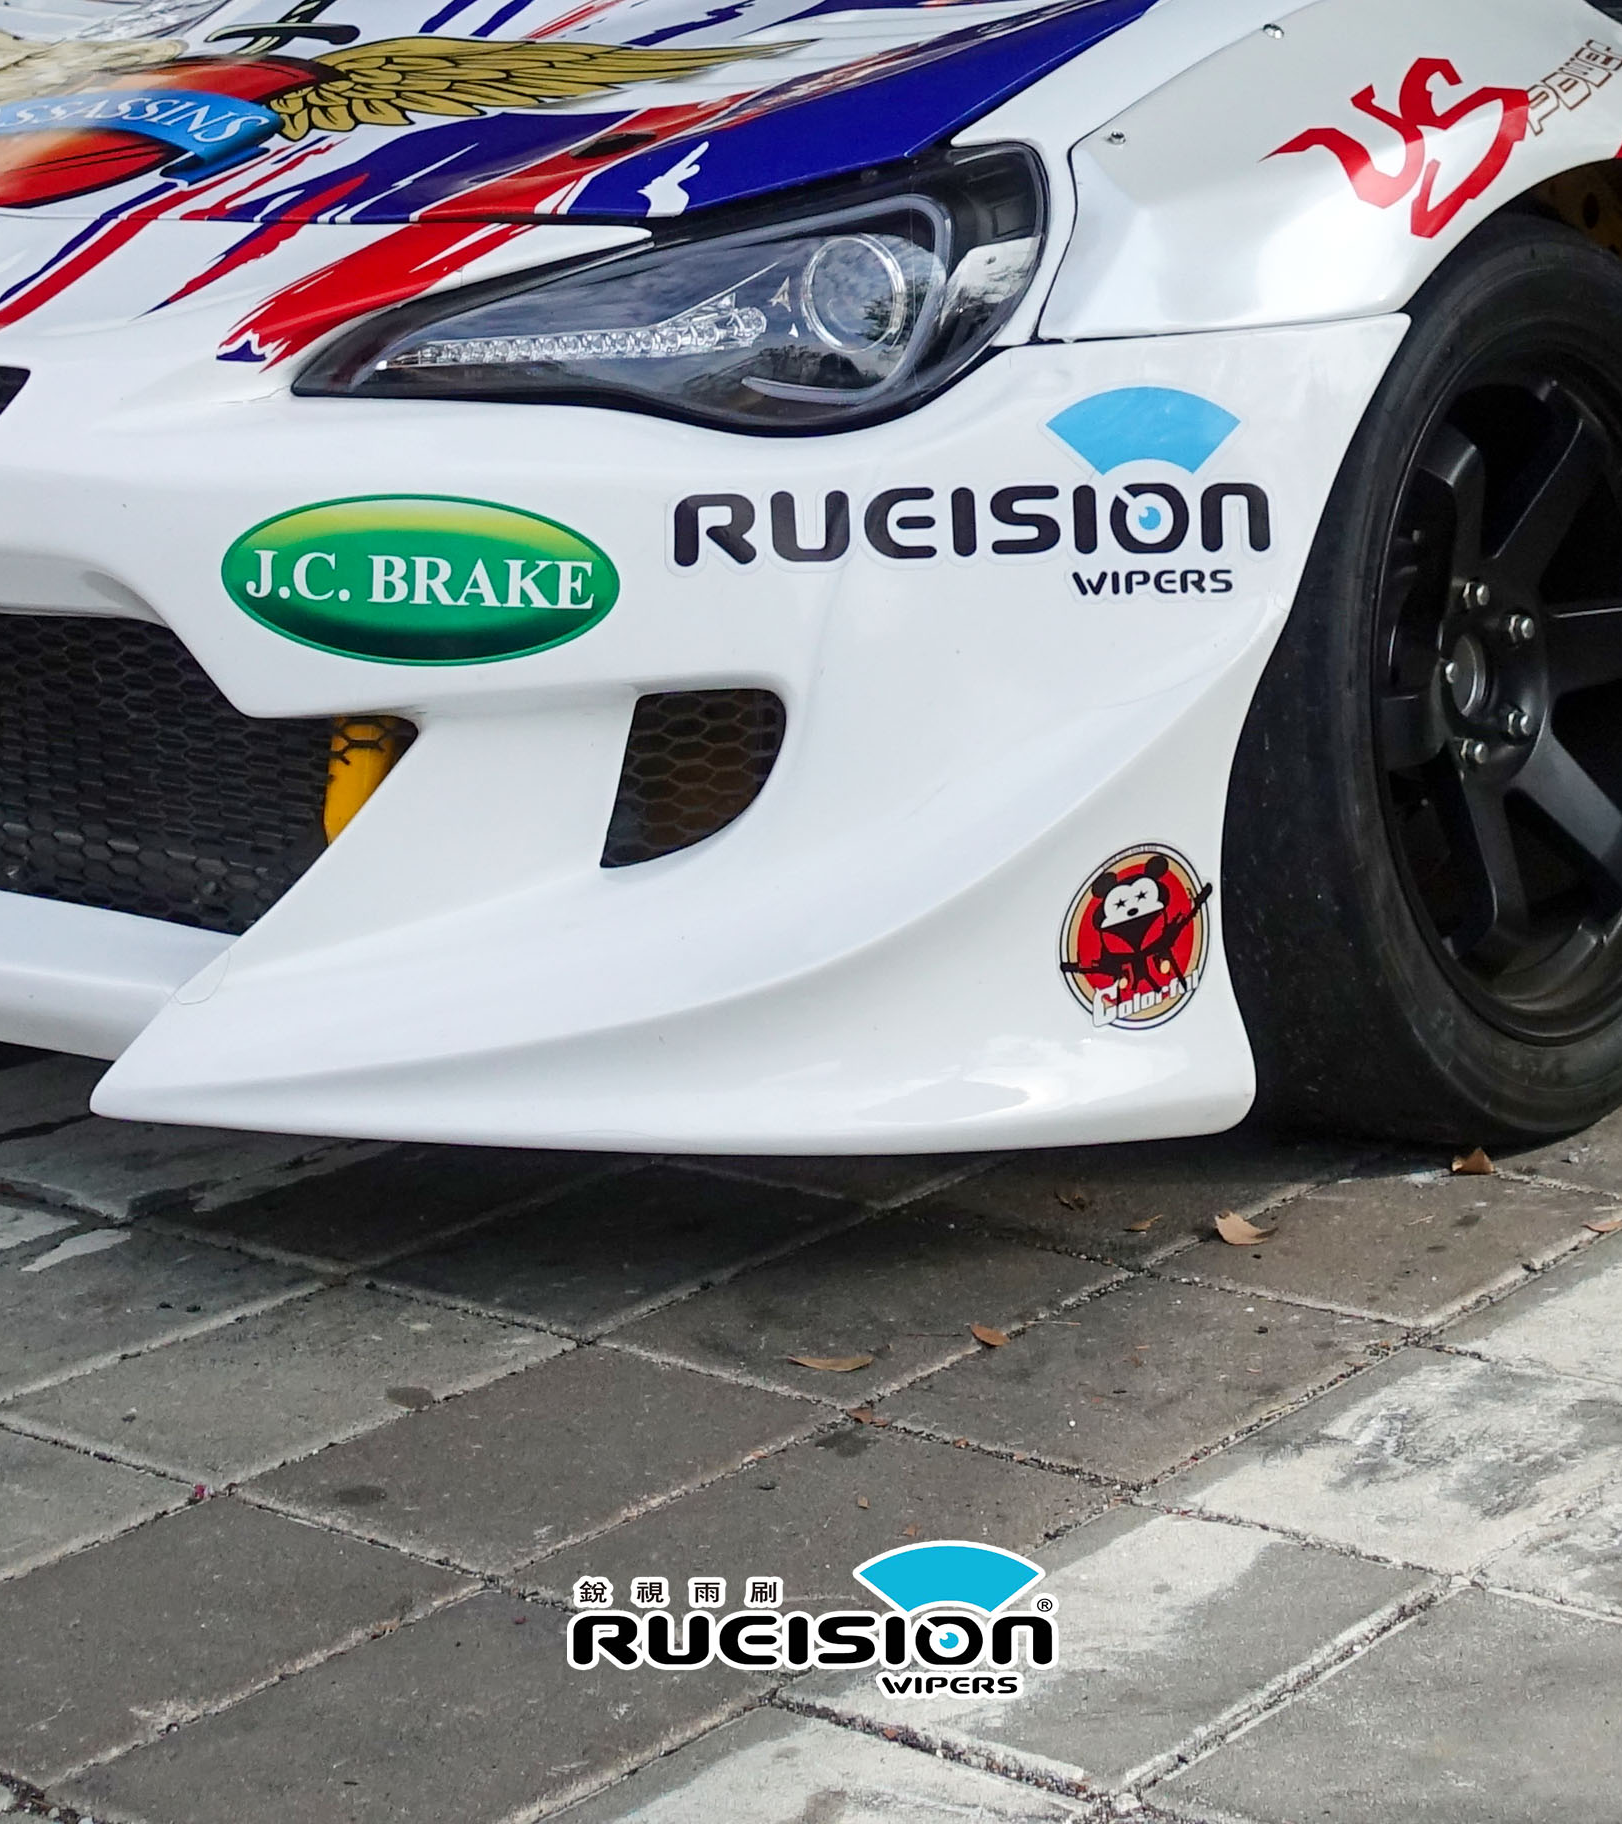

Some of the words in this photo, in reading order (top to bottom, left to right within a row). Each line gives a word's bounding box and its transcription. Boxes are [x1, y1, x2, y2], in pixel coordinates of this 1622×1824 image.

[245, 550, 350, 601] J.C.
[369, 558, 594, 611] BRAKE
[1071, 568, 1234, 596] WIPERS
